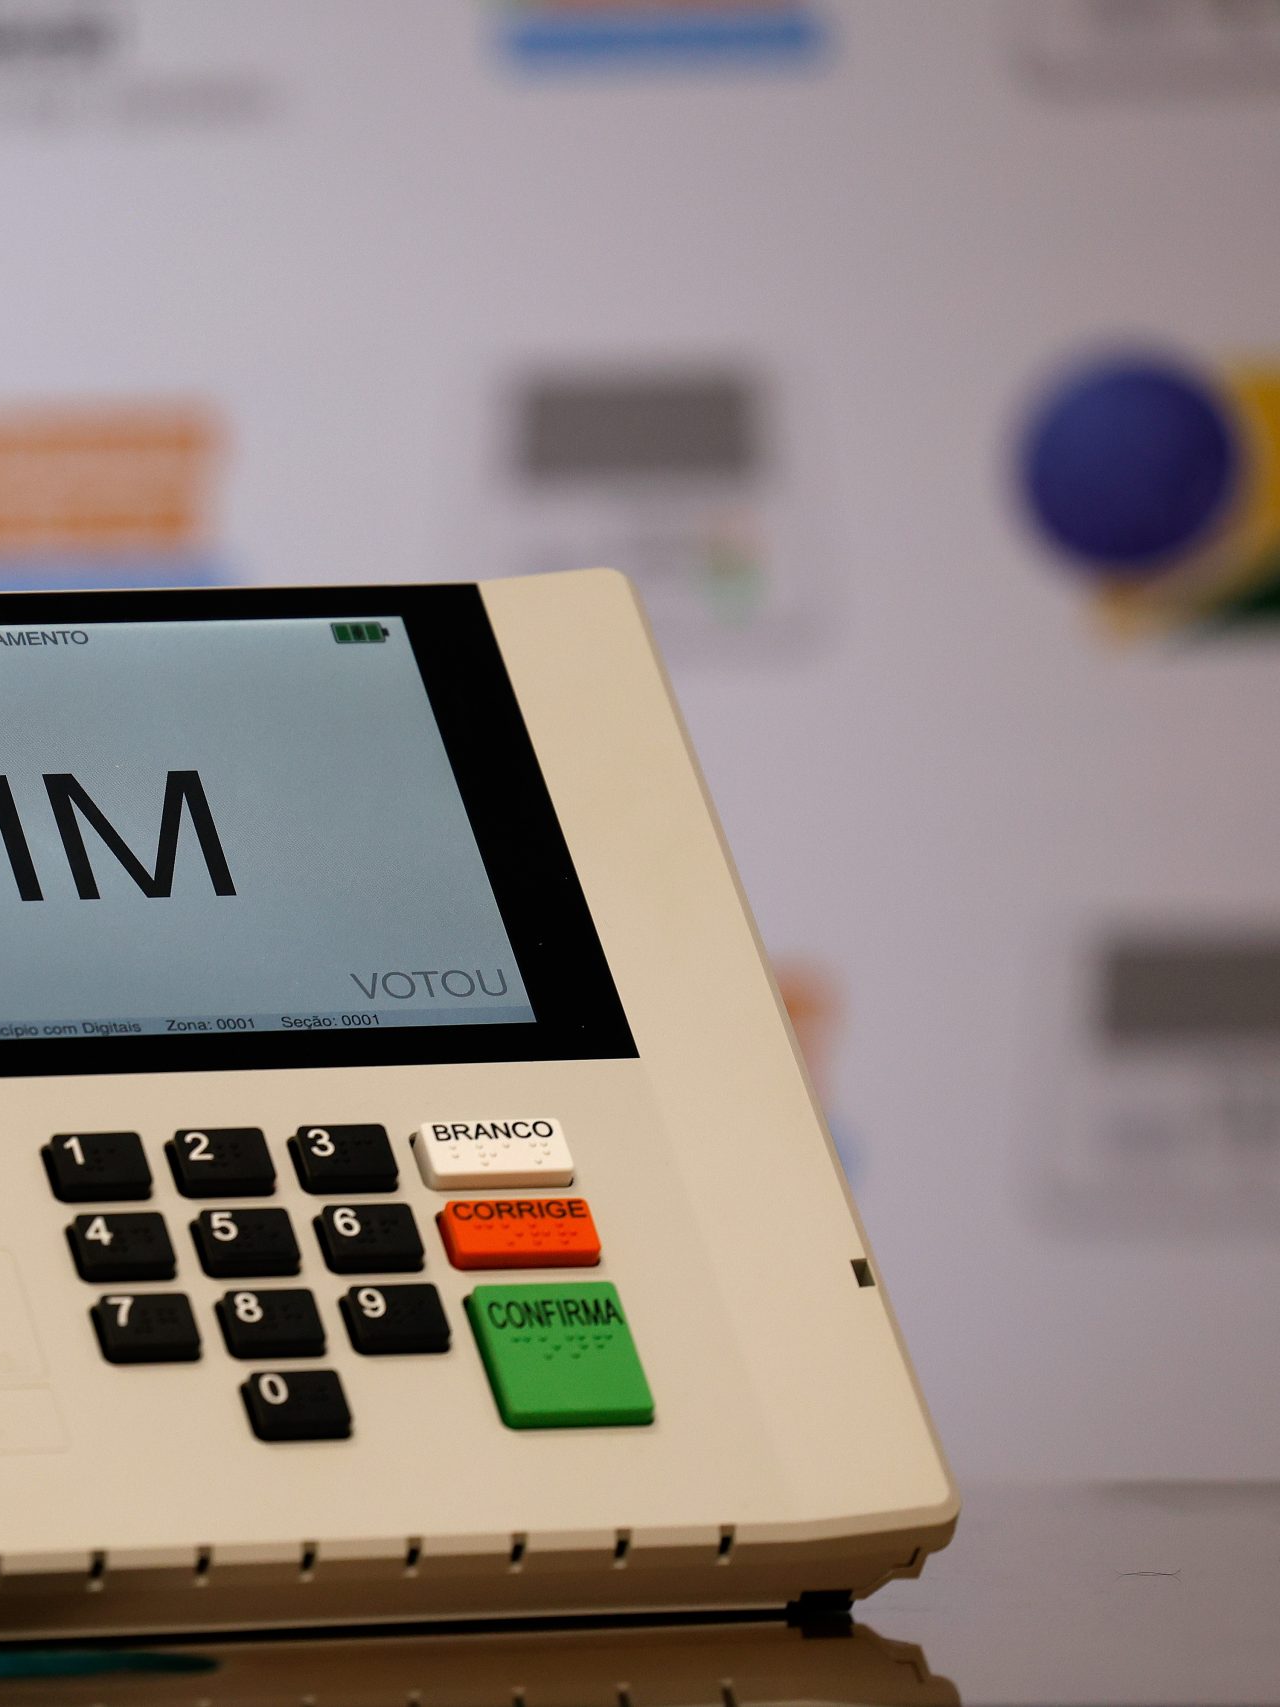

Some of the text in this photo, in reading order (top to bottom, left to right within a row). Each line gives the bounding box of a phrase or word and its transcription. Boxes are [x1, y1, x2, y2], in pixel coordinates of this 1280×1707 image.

[350, 968, 508, 1000] VOTOU
[43, 1023, 78, 1036] com
[82, 1020, 142, 1036] Digitais
[165, 1017, 256, 1032] Zona: 0001
[281, 1013, 380, 1030] Seção: 0001
[308, 1128, 336, 1157] 3
[431, 1119, 555, 1143] BRANCO
[63, 1136, 87, 1165] 1
[184, 1132, 215, 1161] 2
[332, 1208, 362, 1238] 6
[452, 1200, 588, 1222] CORRIGE
[85, 1216, 114, 1246] 4
[210, 1212, 239, 1242] 5
[107, 1296, 135, 1327] 7
[233, 1292, 263, 1324] 8
[357, 1287, 387, 1319] 9
[487, 1299, 624, 1331] CONFIRMA
[258, 1373, 290, 1404] 0
